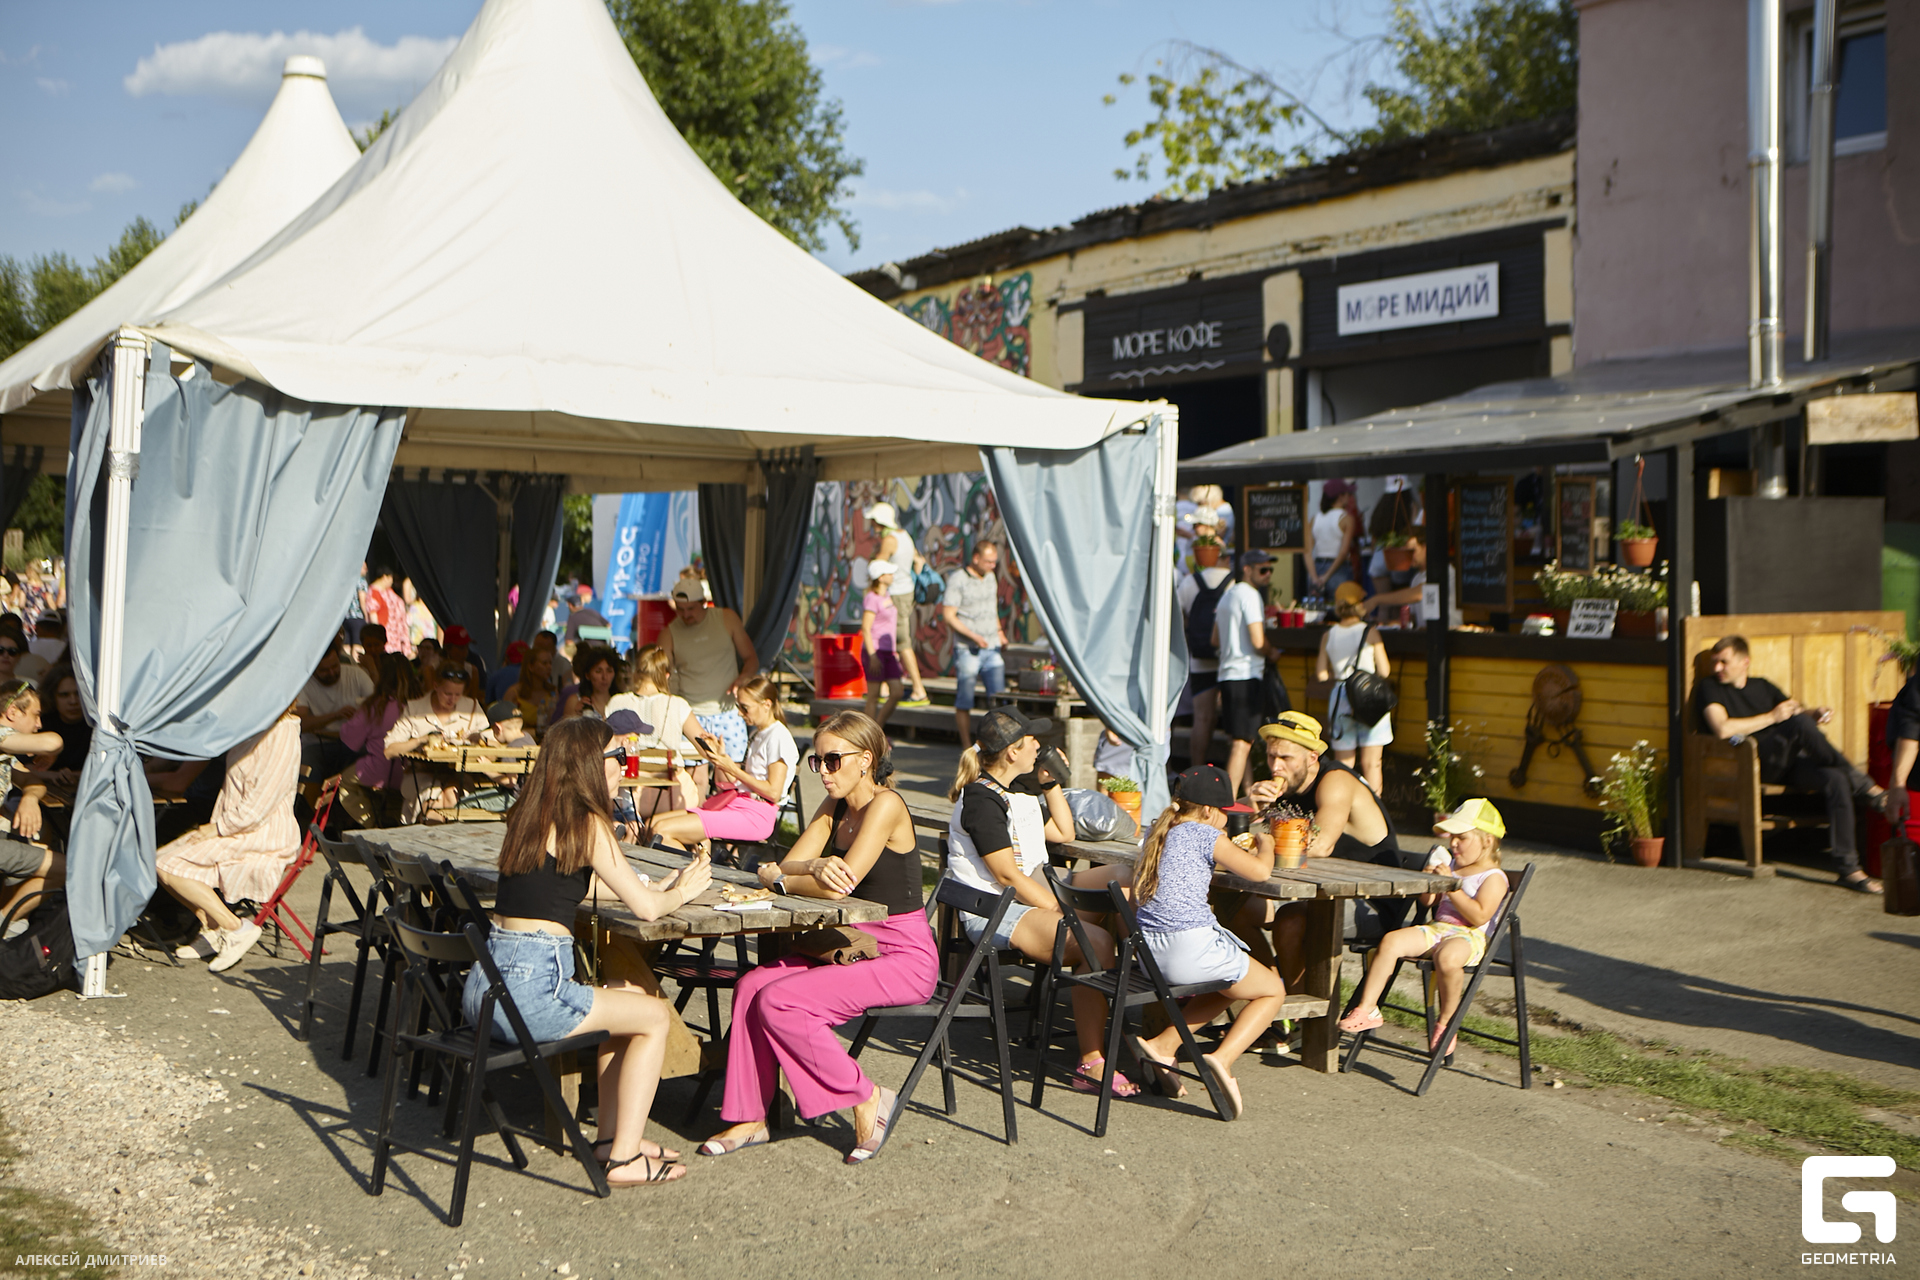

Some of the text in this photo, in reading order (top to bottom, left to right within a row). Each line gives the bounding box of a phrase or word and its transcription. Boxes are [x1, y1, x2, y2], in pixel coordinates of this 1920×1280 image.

[1406, 273, 1490, 317] МИДИЙ
[1112, 321, 1224, 361] МОРЕ КОФЕ
[1269, 529, 1288, 547] 120
[608, 526, 638, 617] ГИРОС
